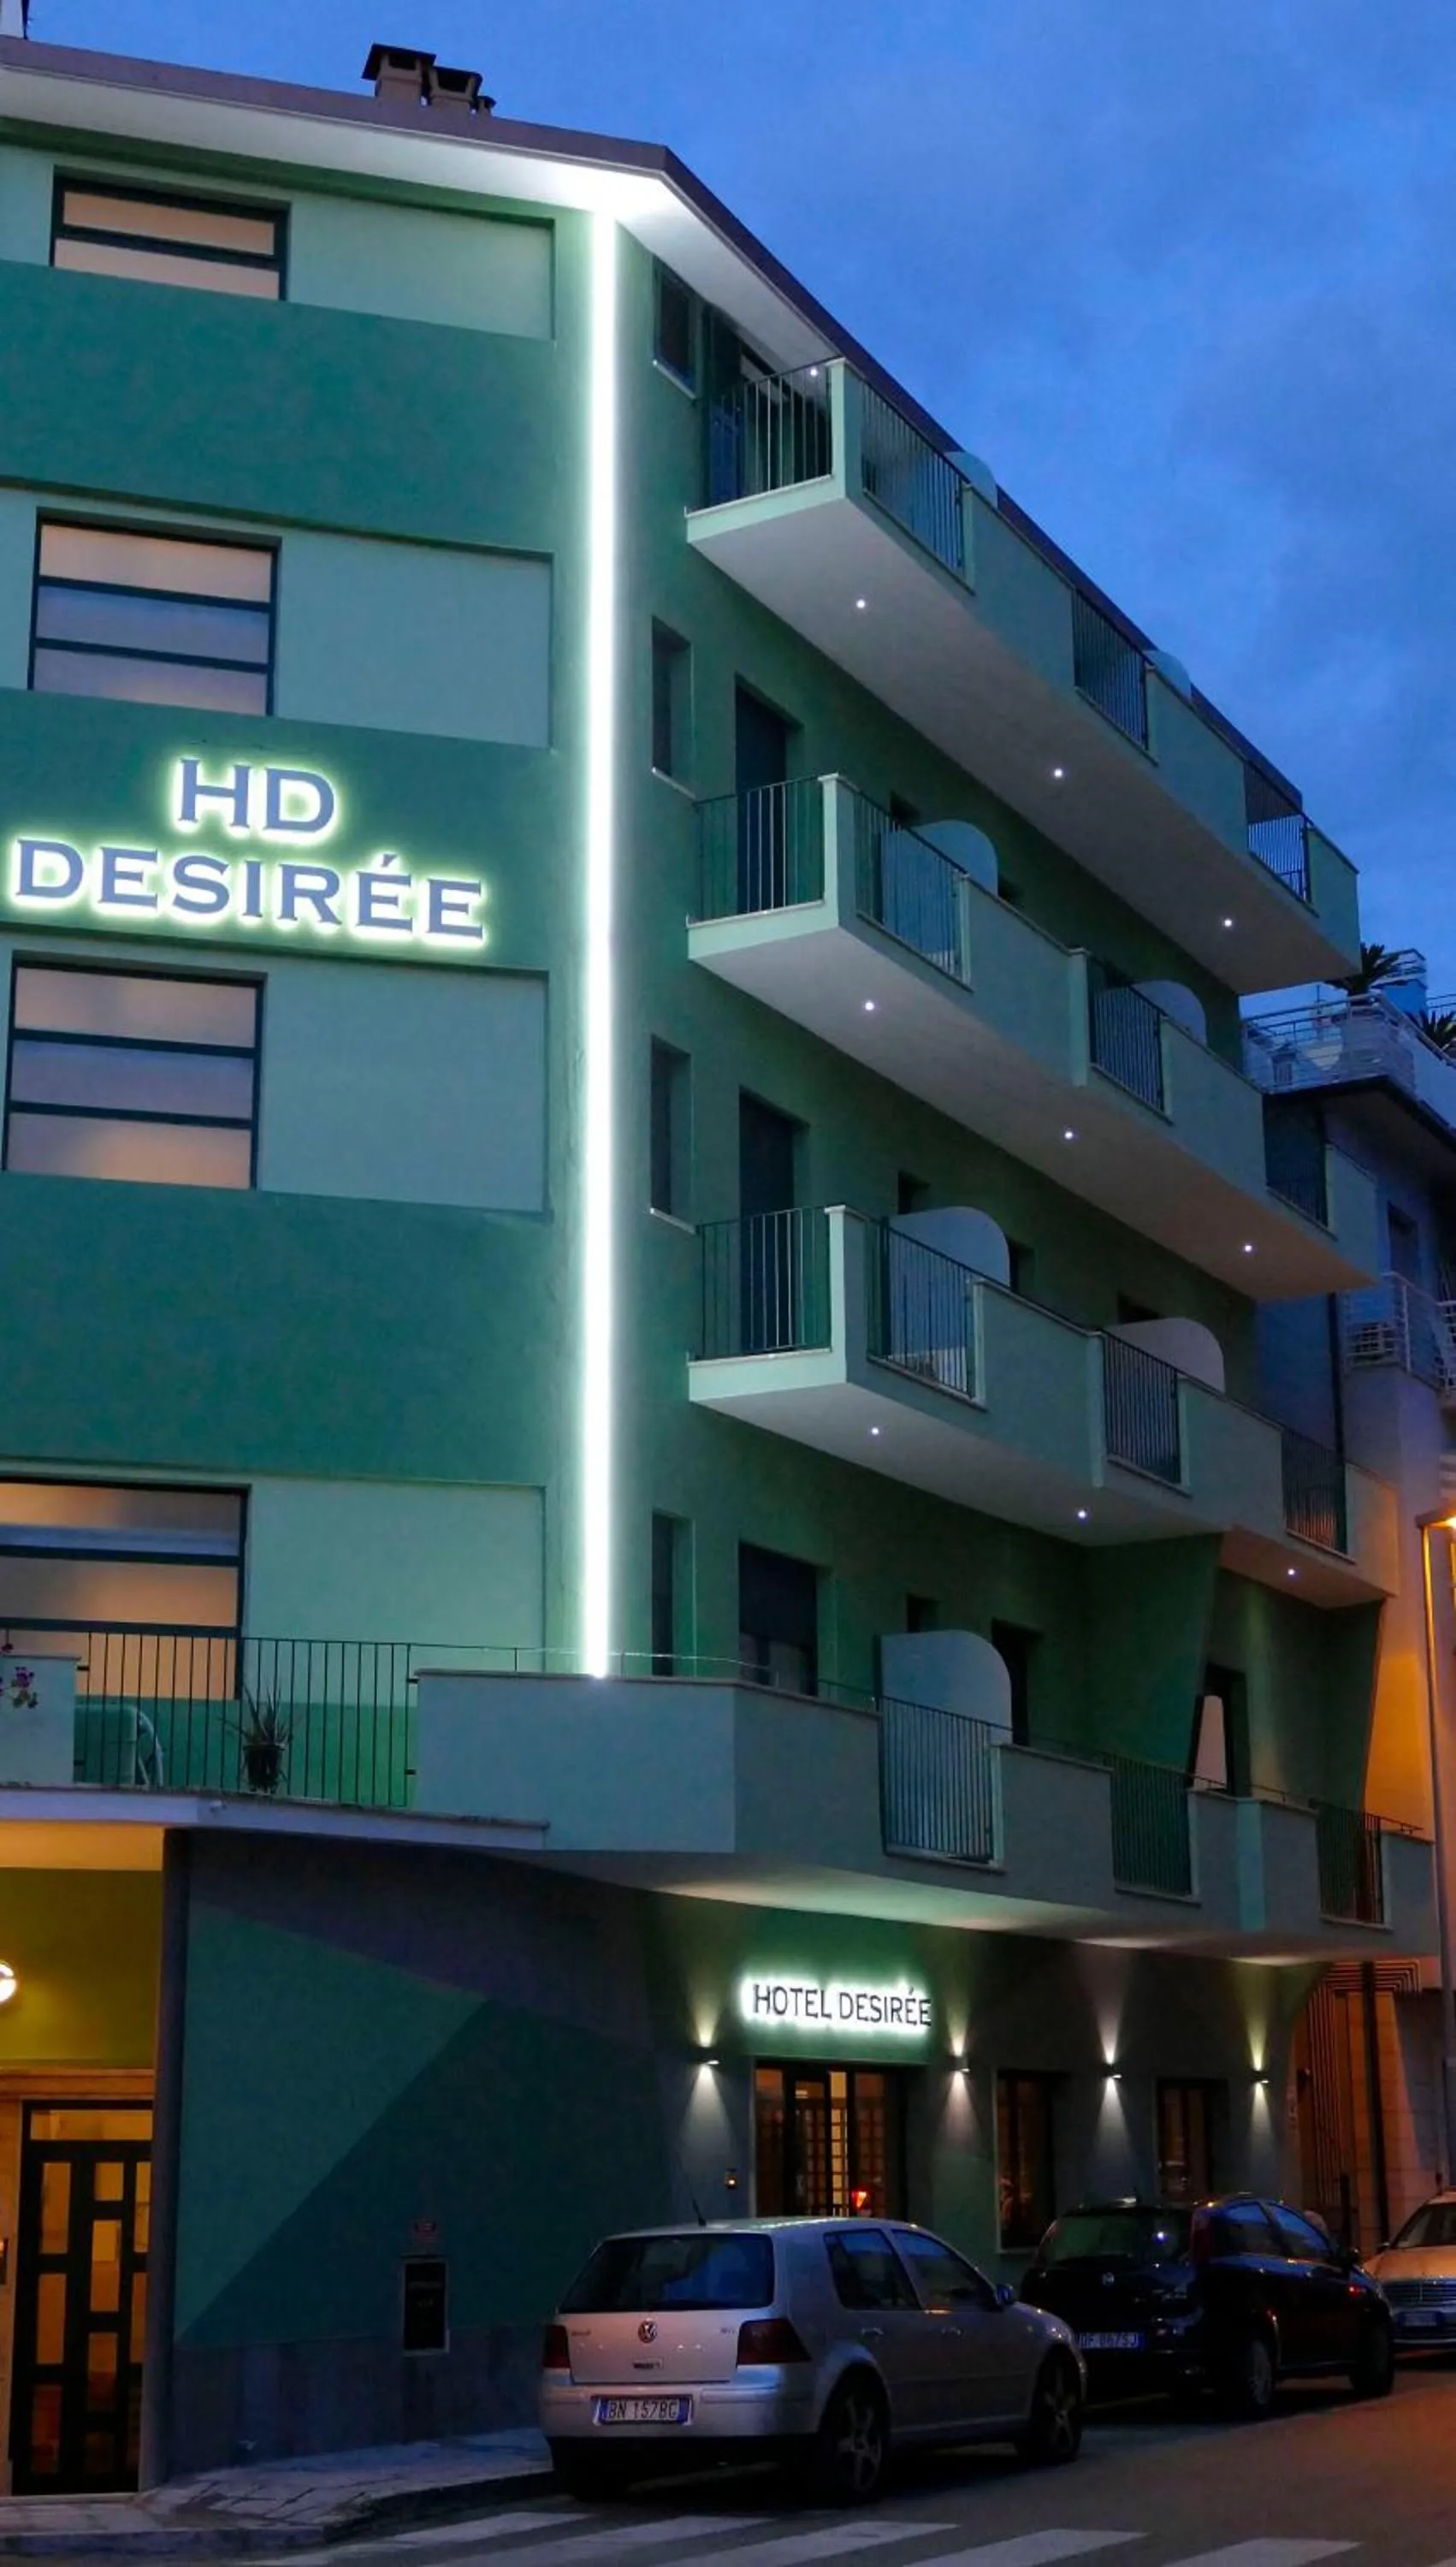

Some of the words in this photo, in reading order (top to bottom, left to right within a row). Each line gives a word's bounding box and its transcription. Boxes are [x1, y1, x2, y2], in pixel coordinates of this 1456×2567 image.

[177, 758, 336, 834] HD
[15, 838, 485, 940] DESIRÉE
[752, 1983, 832, 2020] HOTEL
[838, 1986, 932, 2027] DESIRÉE
